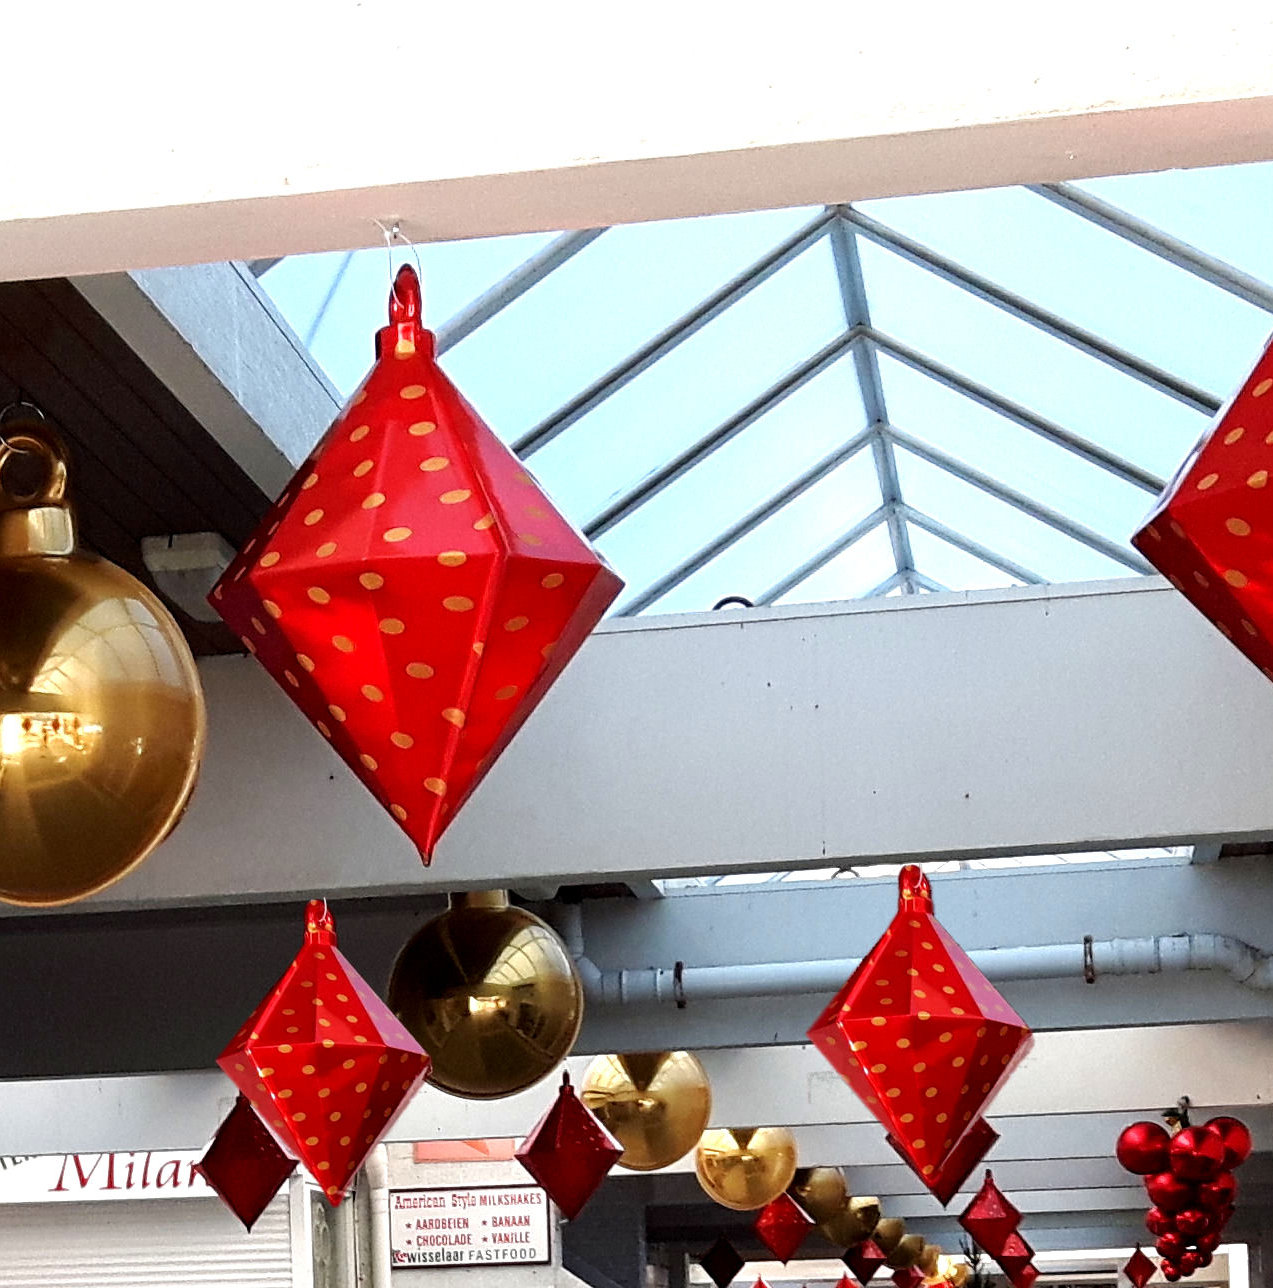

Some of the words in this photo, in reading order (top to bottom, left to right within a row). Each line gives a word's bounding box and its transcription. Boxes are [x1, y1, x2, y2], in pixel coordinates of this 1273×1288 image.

[394, 1194, 446, 1210] American
[451, 1193, 477, 1210] Style
[479, 1193, 542, 1207] MILKSHAKES
[415, 1217, 469, 1231] AARDBEIEN
[492, 1215, 531, 1228] BANAAN
[416, 1234, 472, 1248] CHOCOLADE
[492, 1231, 531, 1244] VANILLE
[468, 1248, 537, 1262] FASTFOOD
